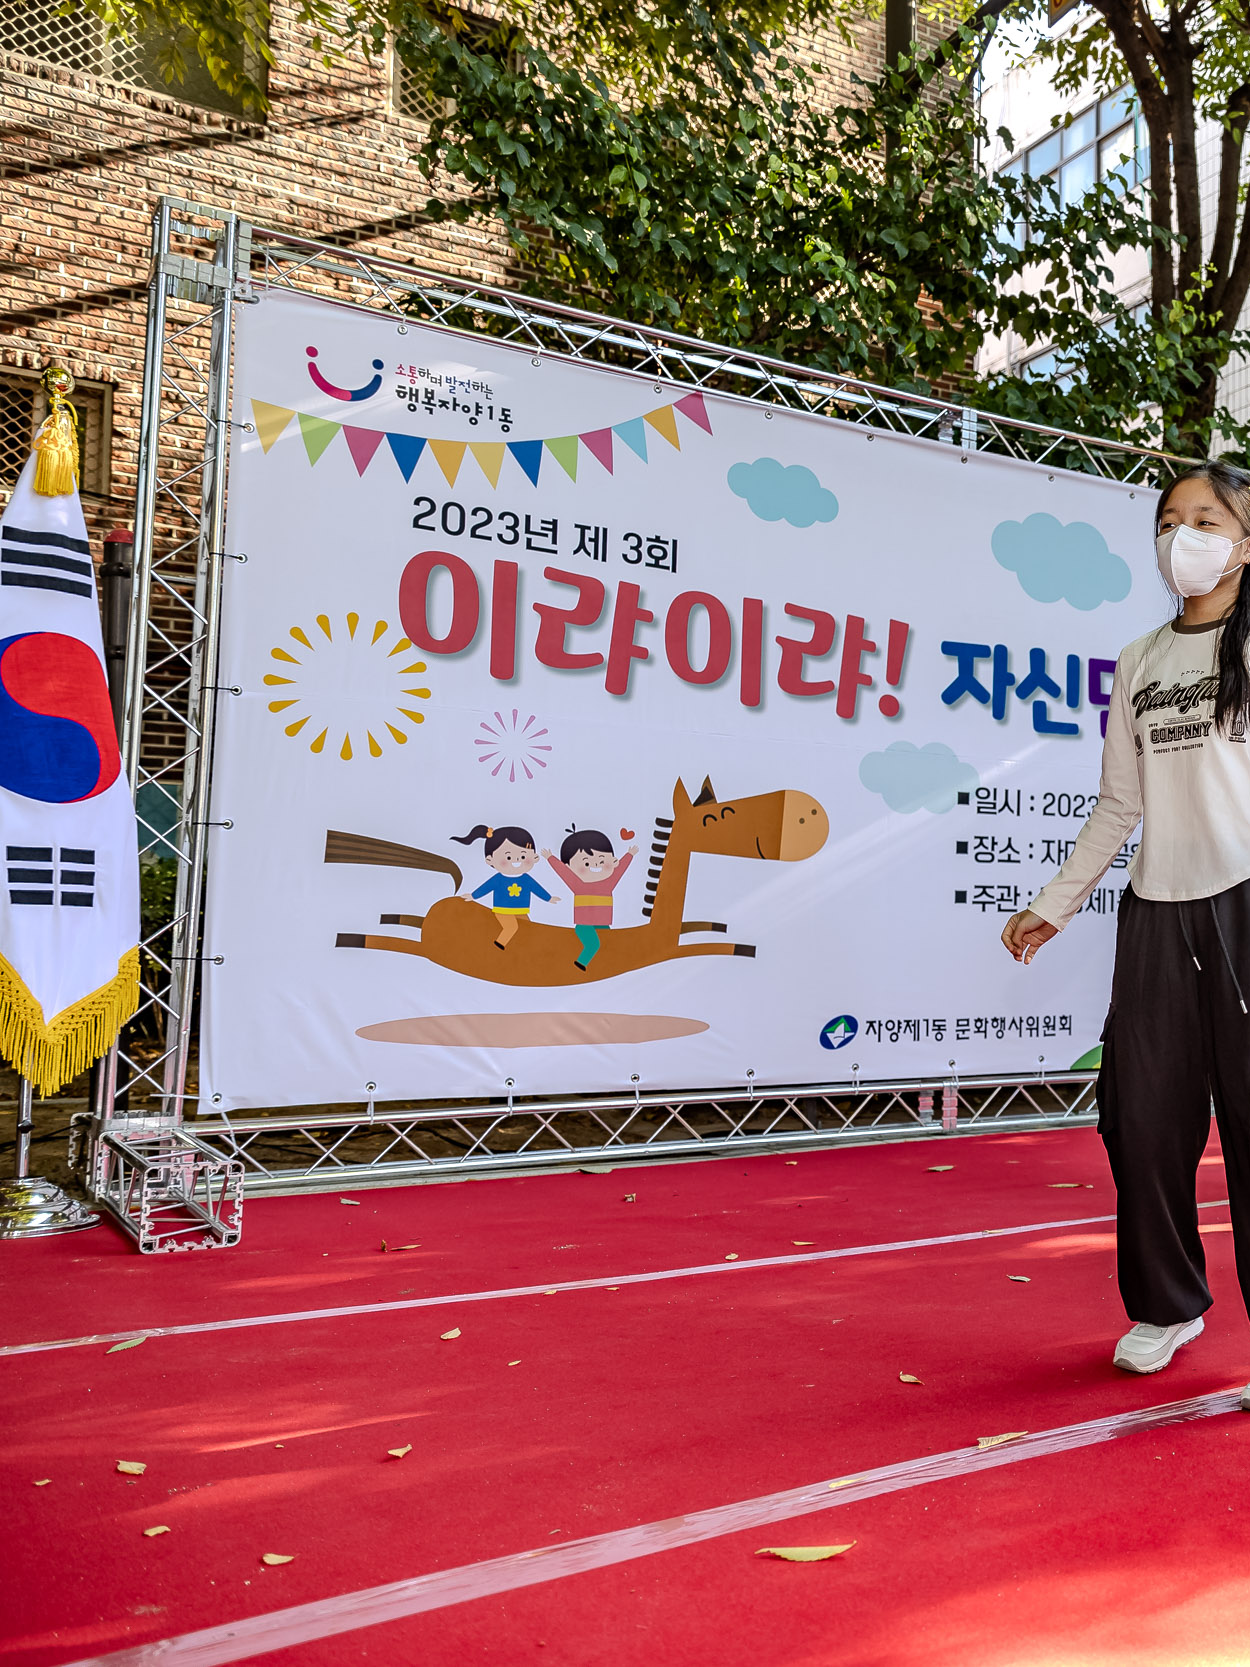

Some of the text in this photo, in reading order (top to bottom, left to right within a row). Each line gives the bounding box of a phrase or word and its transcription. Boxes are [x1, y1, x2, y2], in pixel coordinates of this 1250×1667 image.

[395, 364, 494, 401] 소통하며 발전하는
[411, 496, 680, 574] 2023년 제 3회
[399, 550, 910, 719] 이랴이랴!
[975, 787, 1021, 816] 일시
[973, 836, 1021, 864] 장소
[972, 885, 1021, 912] 주관
[865, 1014, 1072, 1042] 자양제1동 문화행사위원회
